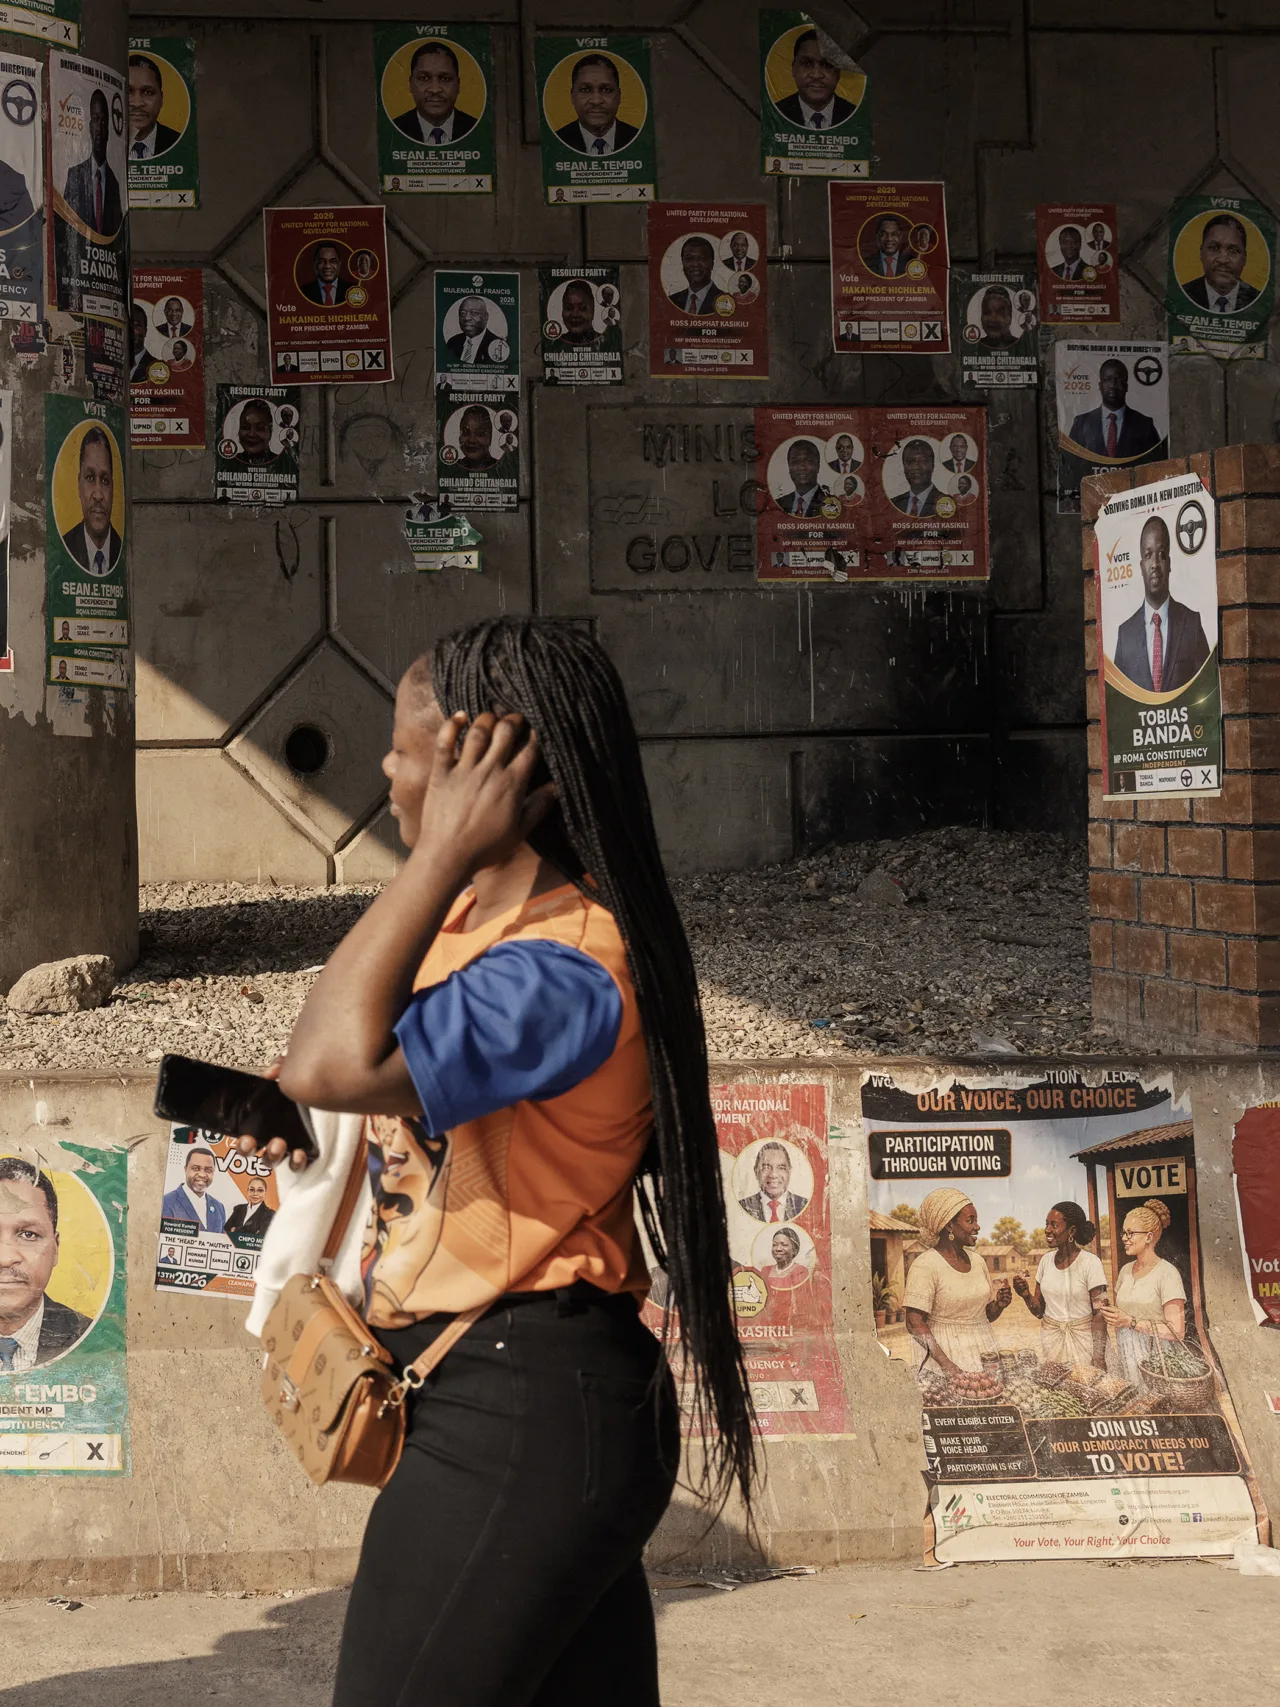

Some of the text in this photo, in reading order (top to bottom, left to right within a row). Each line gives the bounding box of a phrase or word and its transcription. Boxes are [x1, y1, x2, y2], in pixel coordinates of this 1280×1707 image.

[415, 26, 448, 36] VOTE
[392, 150, 425, 160] SEAN
[440, 150, 481, 160] TEMBO
[839, 274, 859, 283] Vote
[443, 287, 475, 295] MULENGA
[842, 286, 936, 294] HAKAINDE HICHILEMA
[690, 320, 719, 328] JOSPHAT
[963, 356, 1037, 366] CHILANDO CHITANGALA
[229, 386, 287, 397] RESOLUTE PARTY
[217, 471, 297, 484] CHILANDO CHITANGALA
[426, 527, 469, 538] TEMBO
[1113, 552, 1130, 563] VOTE
[1106, 564, 1132, 583] 2026
[1138, 706, 1188, 726] TOBIAS
[1132, 726, 1193, 747] BANDA
[1122, 747, 1208, 763] ROMA CONSTITUENCY
[733, 1099, 790, 1112] NATIONAL
[916, 1087, 1137, 1114] OUR VOICE, OUR CHOICE
[885, 1135, 995, 1153] PARTICIPATION
[215, 1148, 272, 1178] Vote
[882, 1155, 1002, 1173] THROUGH VOTING
[1119, 1163, 1180, 1190] VOTE
[156, 1271, 207, 1288] 13TH 2026
[738, 1325, 794, 1338] KASIKILI
[934, 1415, 1016, 1427] EVERY ELIGIBLE CITIZEN
[1088, 1419, 1159, 1438] JOIN US!
[940, 1436, 981, 1445] MAKE YOUR
[1050, 1437, 1210, 1454] YOUR DEMOCRACY NEEDS YOU
[941, 1445, 988, 1454] VOICE HEARD
[947, 1461, 1023, 1473] PARTICIPATION IS KEY
[1087, 1452, 1186, 1474] TO VOTE!
[1020, 1493, 1058, 1501] COMMISSION
[1013, 1534, 1171, 1548] Your Vote, Your Right, Your Choice
